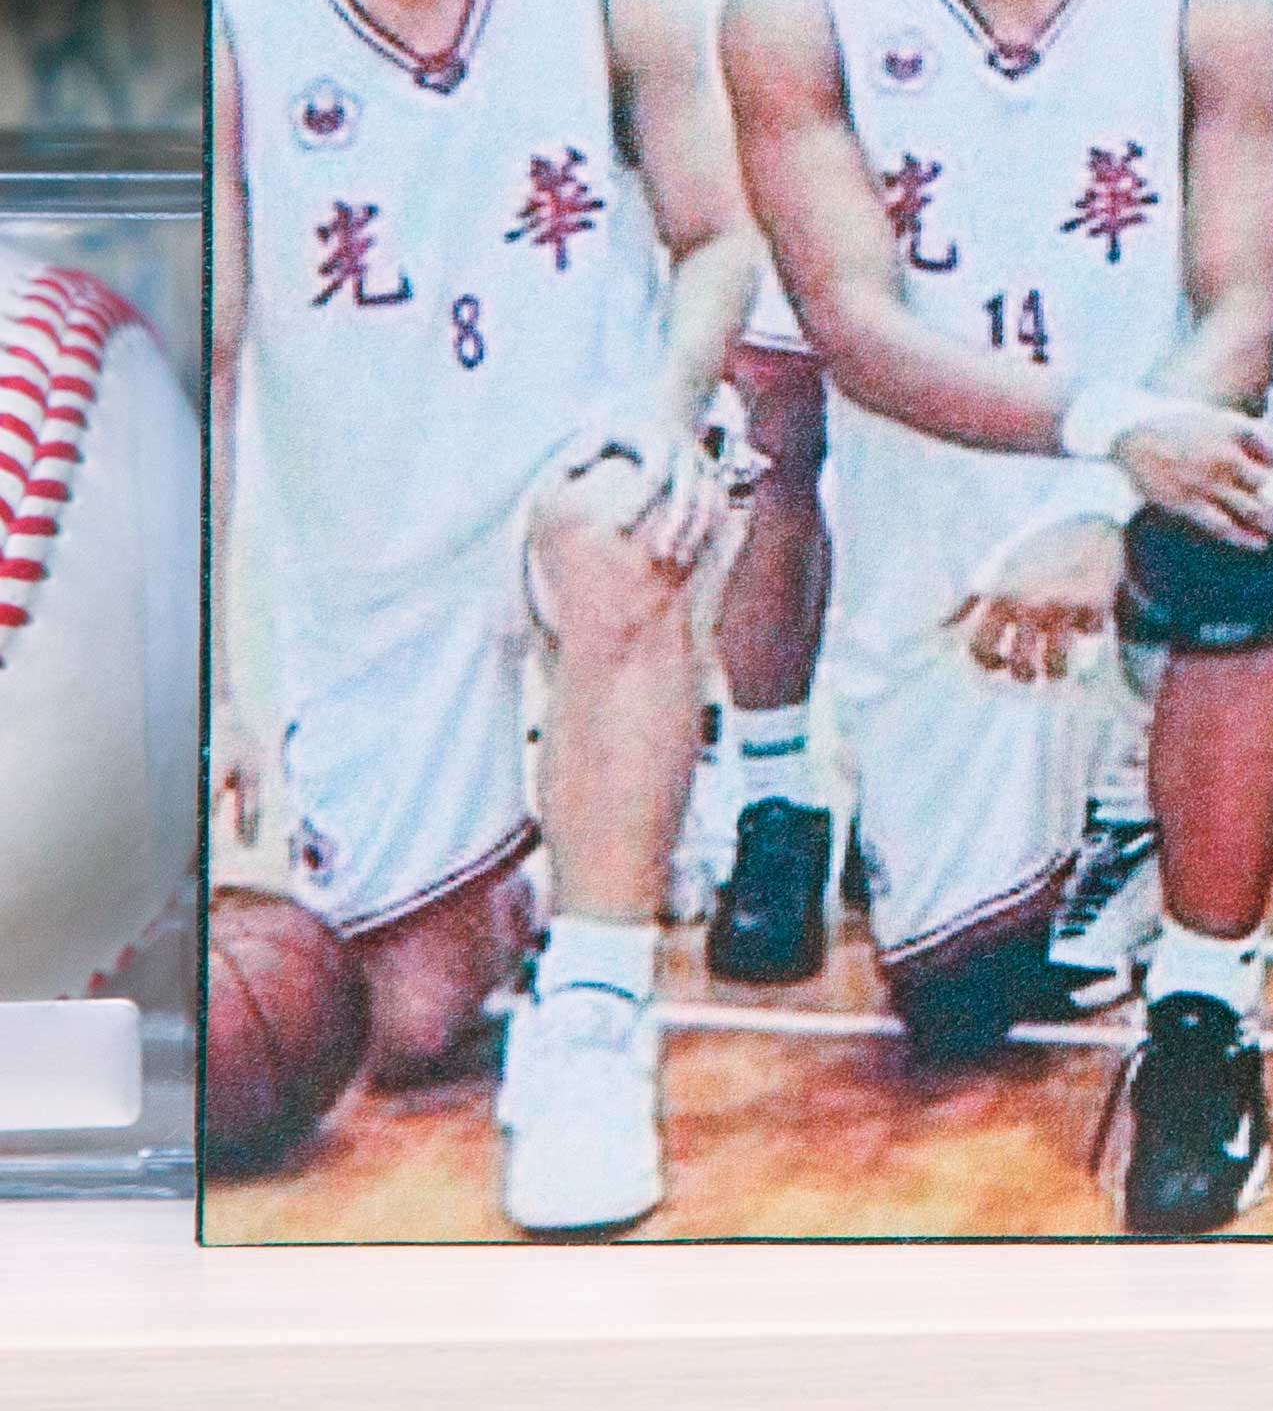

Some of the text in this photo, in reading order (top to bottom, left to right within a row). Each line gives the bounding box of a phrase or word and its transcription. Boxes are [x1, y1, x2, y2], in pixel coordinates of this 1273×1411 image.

[312, 146, 606, 308] 光 華
[1059, 140, 1159, 265] 華
[451, 293, 485, 371] 8
[983, 288, 1050, 366] 14
